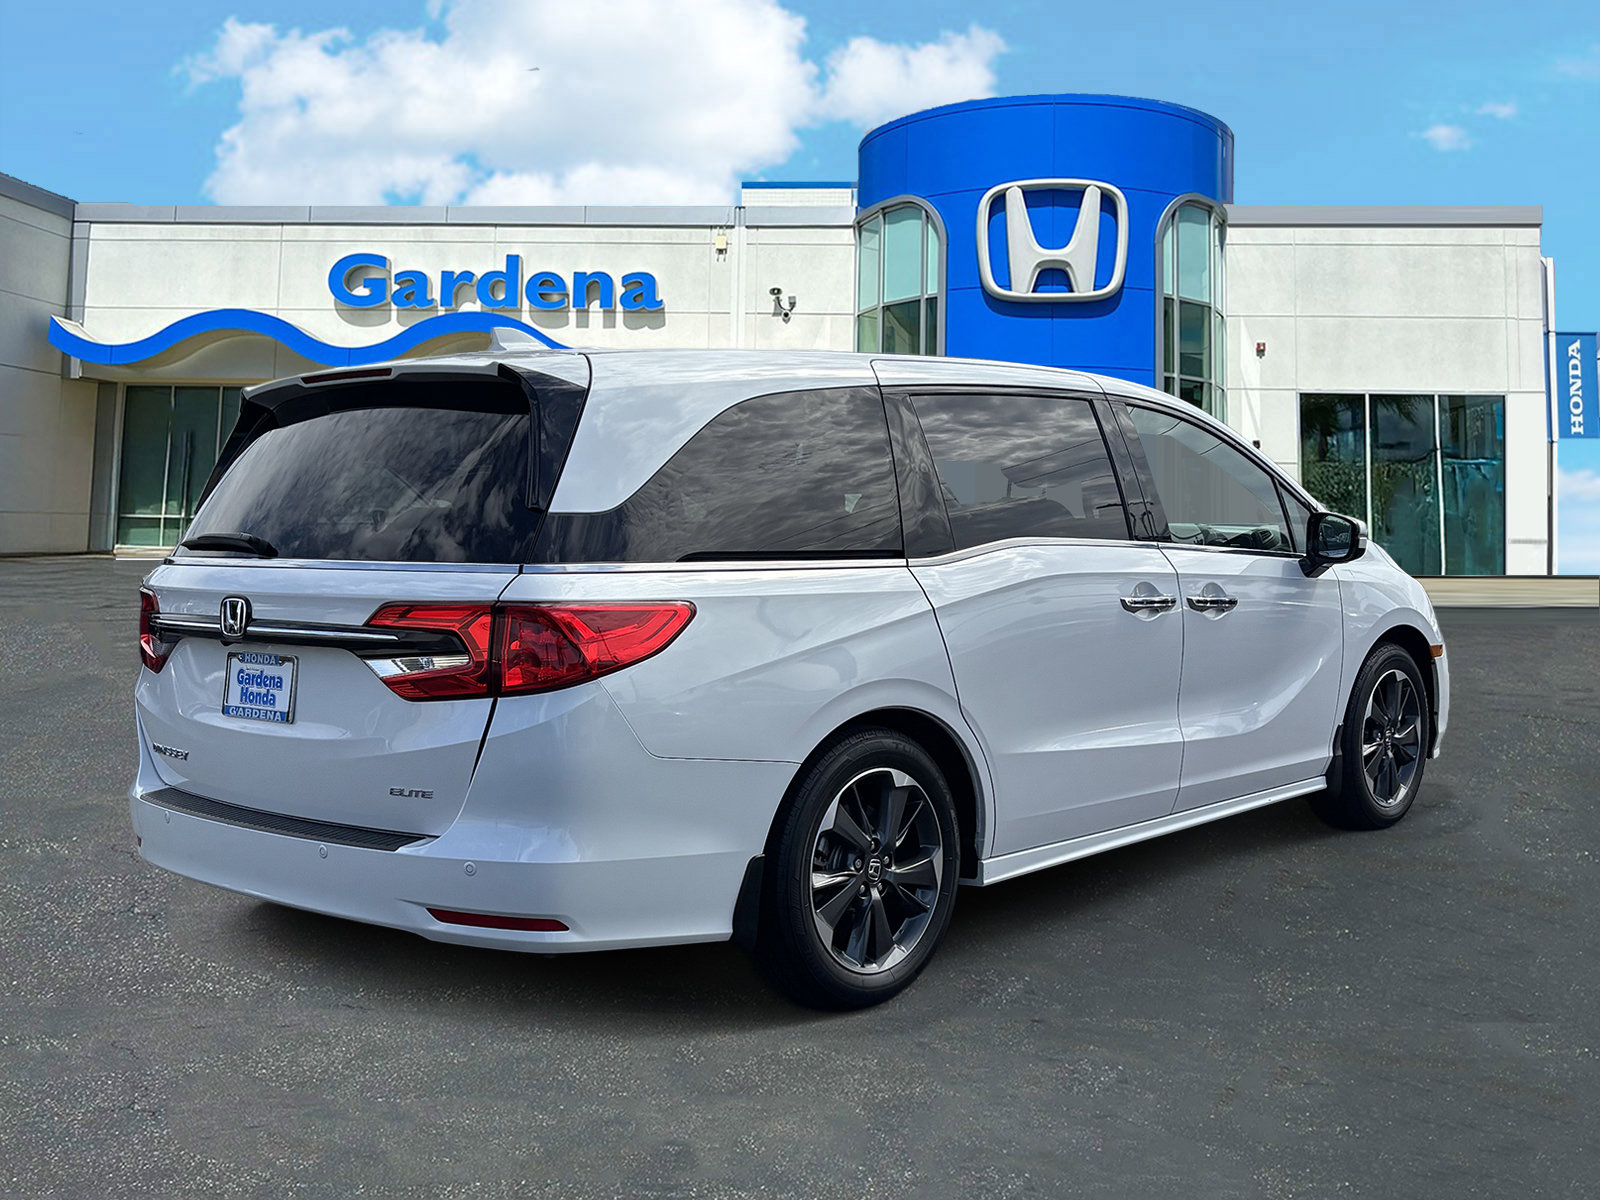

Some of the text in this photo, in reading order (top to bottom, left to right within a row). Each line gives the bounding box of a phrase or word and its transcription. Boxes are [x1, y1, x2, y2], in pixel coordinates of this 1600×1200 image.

[328, 253, 664, 311] Gardena
[1568, 339, 1584, 435] HONDA
[243, 653, 277, 666] HONDA
[236, 668, 283, 691] Gardena
[240, 686, 277, 707] Honda
[228, 706, 283, 722] GARDENA
[152, 742, 190, 761] SSEY
[389, 786, 434, 799] ELITE
